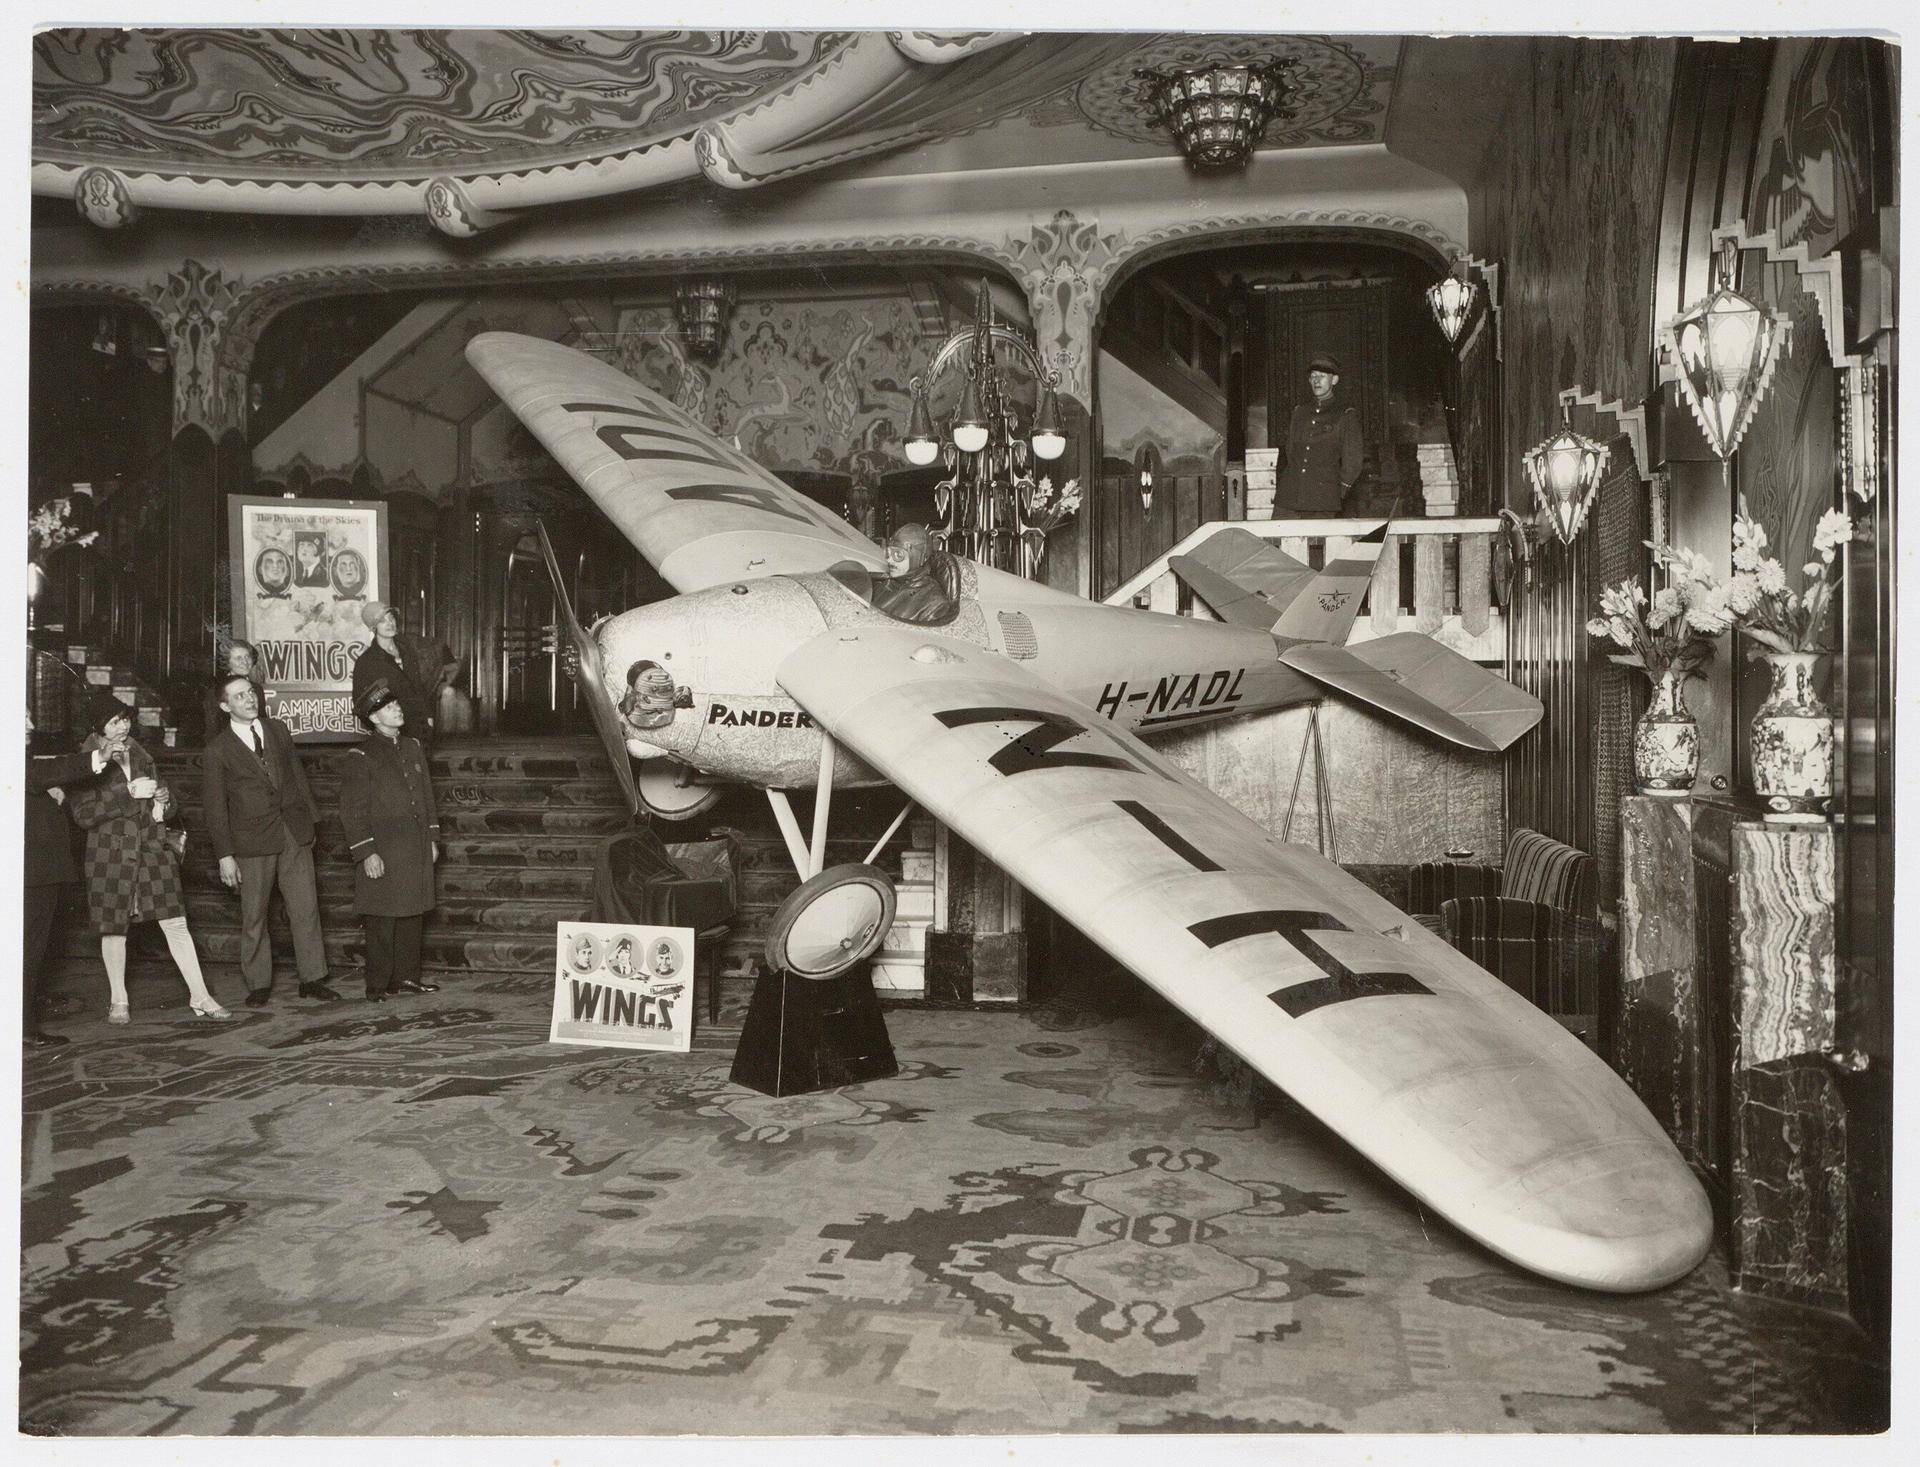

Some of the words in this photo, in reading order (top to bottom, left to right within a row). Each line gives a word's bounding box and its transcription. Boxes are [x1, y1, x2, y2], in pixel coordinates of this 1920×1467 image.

[335, 516, 361, 525] Skies
[1096, 668, 1245, 720] H-NADL
[708, 703, 814, 728] PANDER
[569, 979, 674, 1031] WINGS
